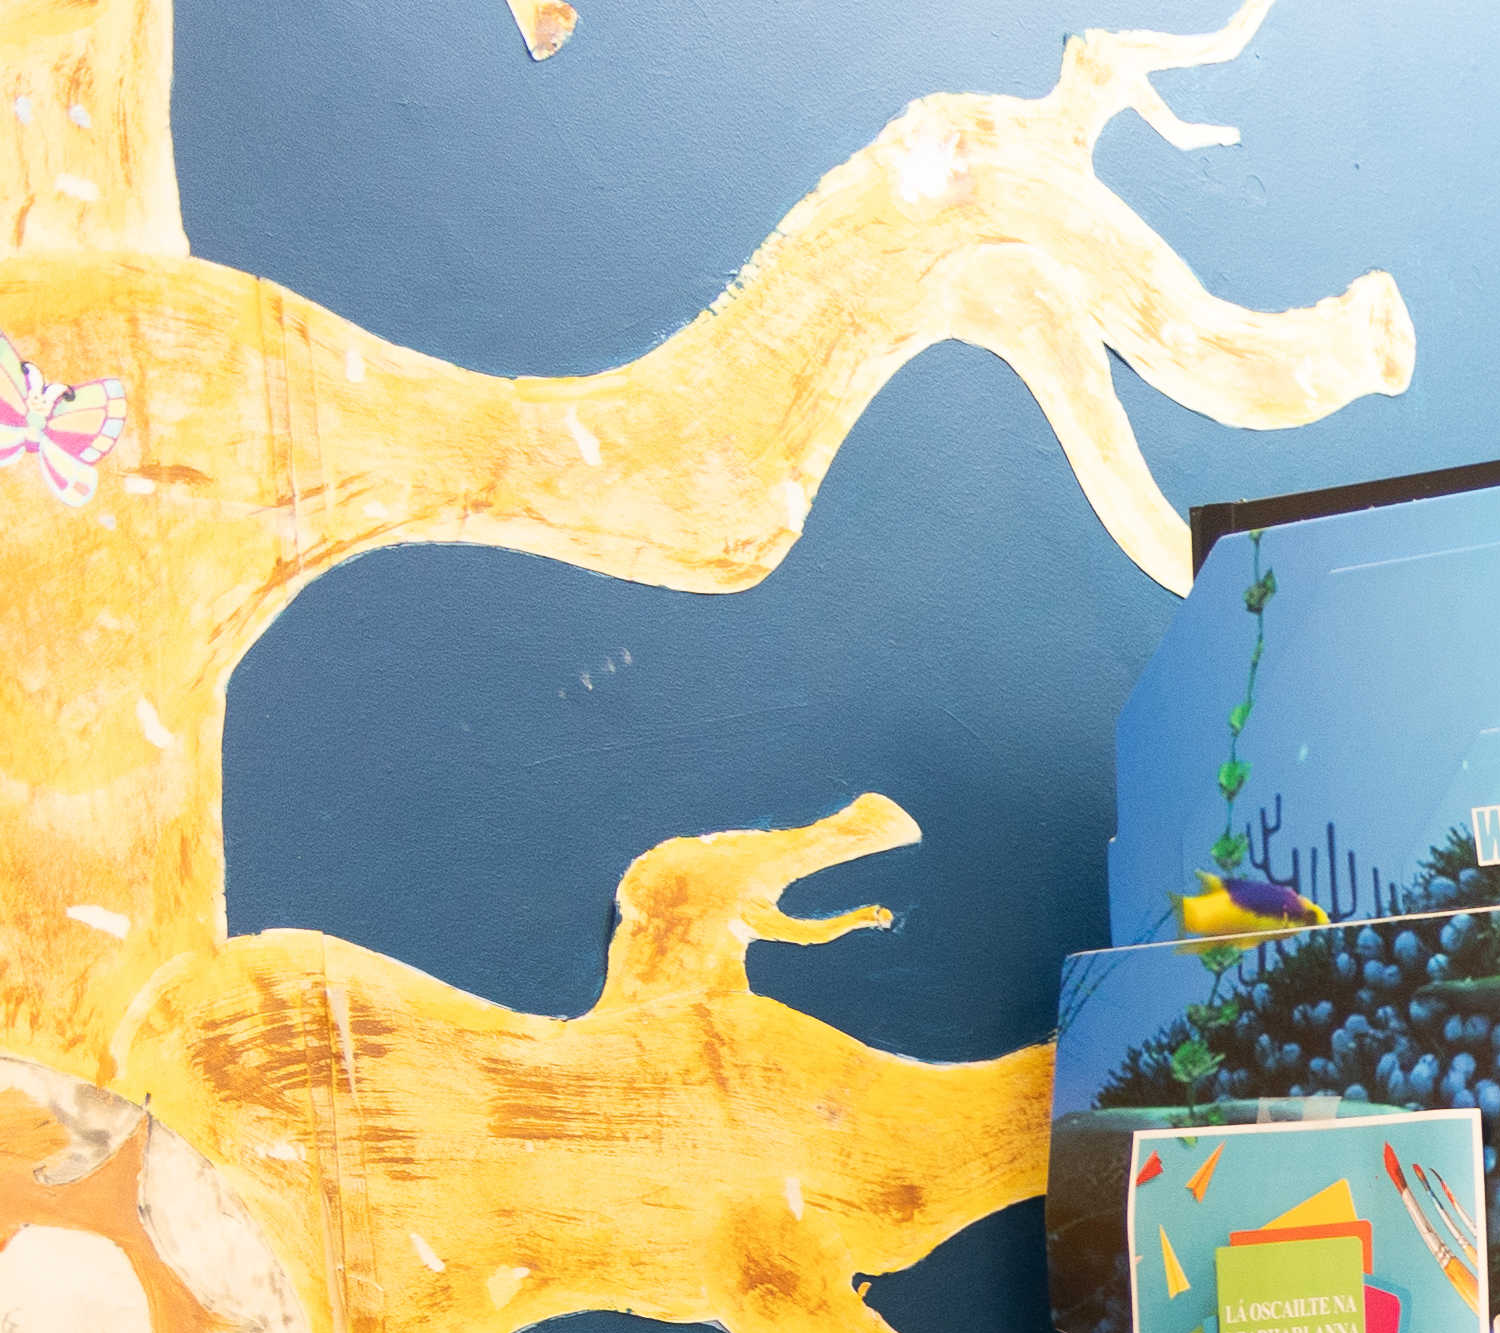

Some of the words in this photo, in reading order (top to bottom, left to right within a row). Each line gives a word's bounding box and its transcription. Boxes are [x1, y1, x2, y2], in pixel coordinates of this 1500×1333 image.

[1225, 1298, 1247, 1324] LÁ
[1249, 1296, 1330, 1321] OSCAILTE
[1333, 1294, 1358, 1314] NA
